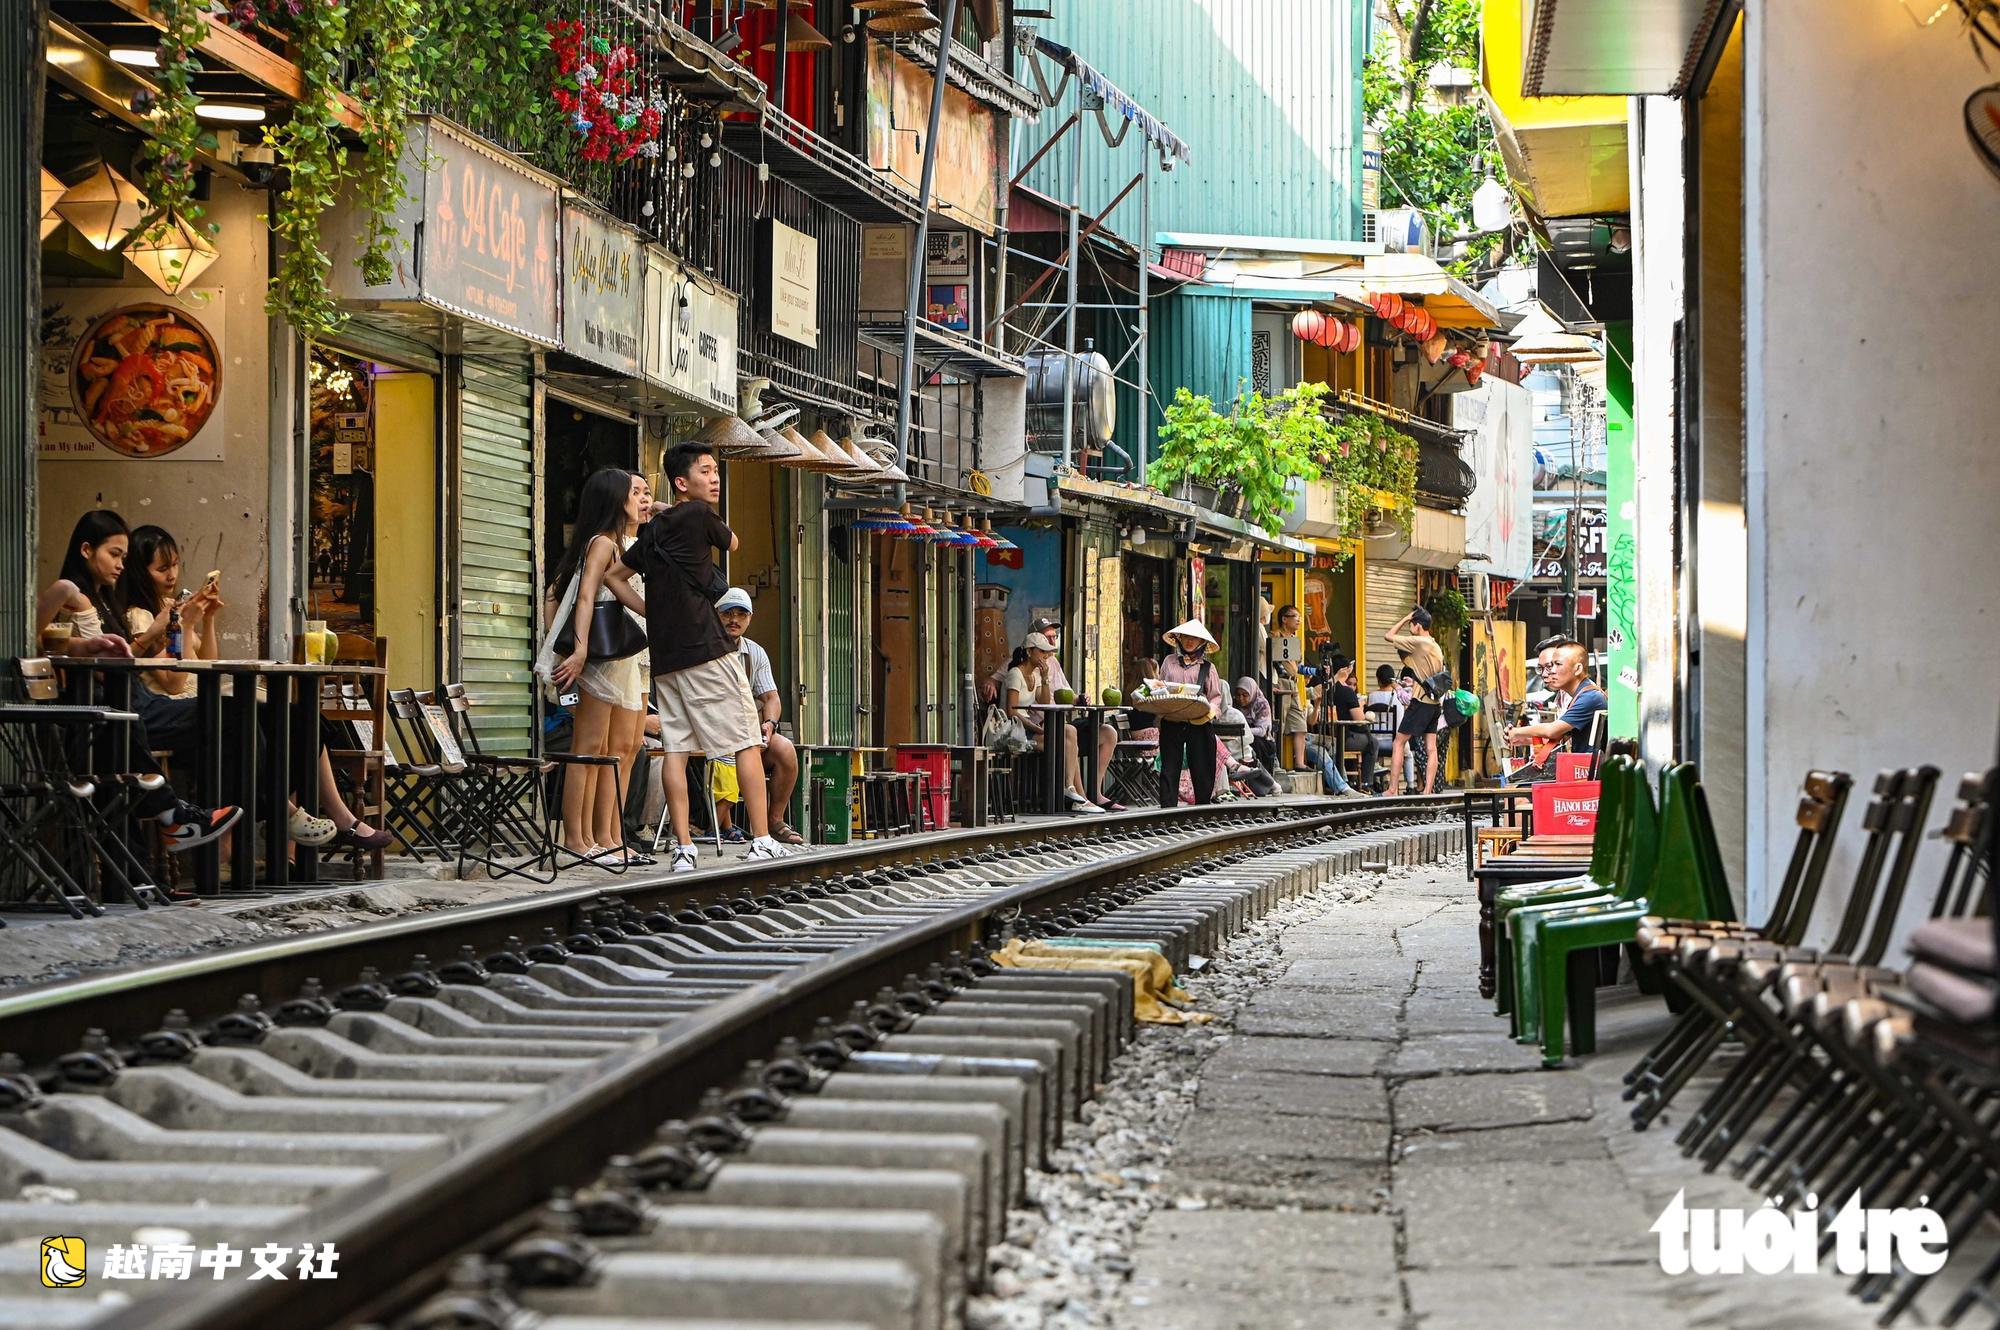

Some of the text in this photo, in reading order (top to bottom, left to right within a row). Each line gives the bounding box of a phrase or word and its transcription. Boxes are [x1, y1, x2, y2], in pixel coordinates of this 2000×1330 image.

[462, 165, 486, 255] 94
[699, 331, 717, 362] COFFEE
[1553, 799, 1580, 814] HANOI
